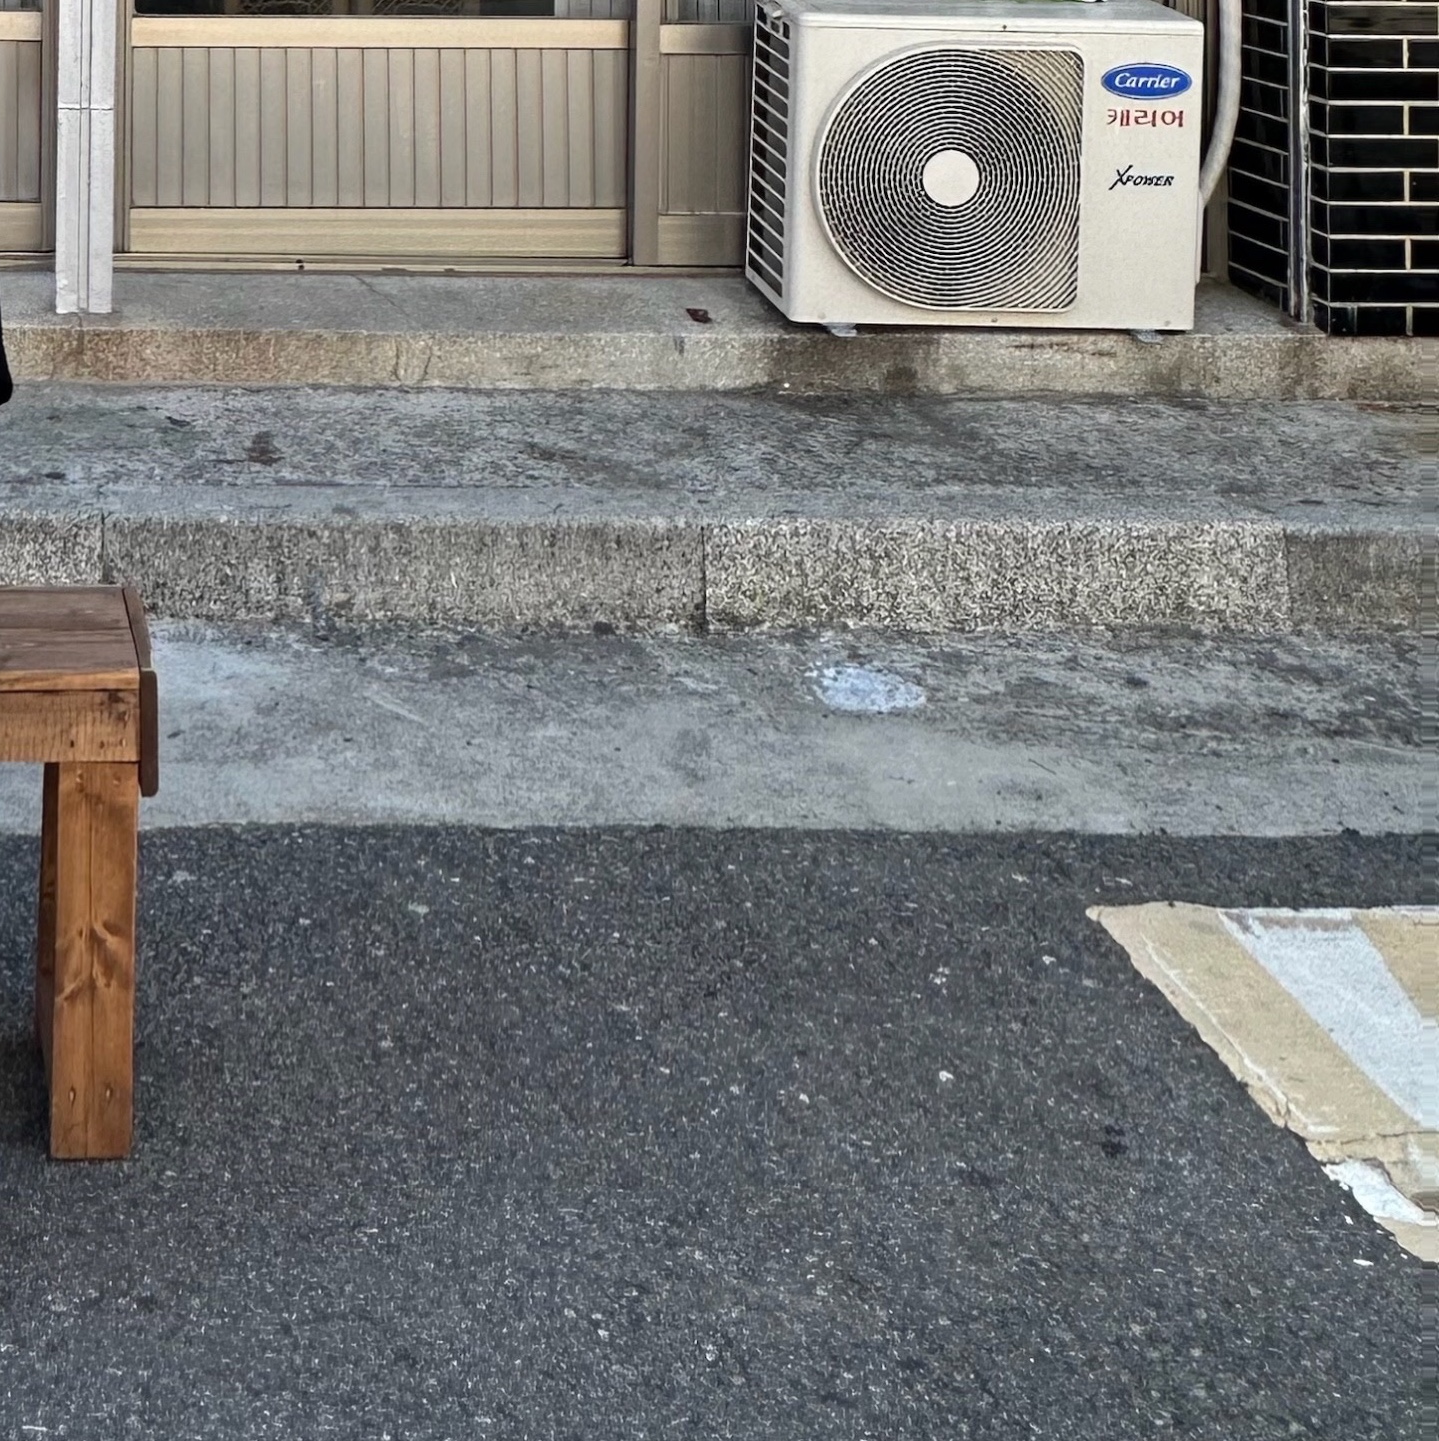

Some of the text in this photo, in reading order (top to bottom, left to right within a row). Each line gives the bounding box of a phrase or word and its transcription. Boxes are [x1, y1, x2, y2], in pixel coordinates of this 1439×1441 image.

[1114, 72, 1181, 89] Carrier
[1106, 108, 1184, 128] 캐리어
[1108, 164, 1175, 191] XPOWER
